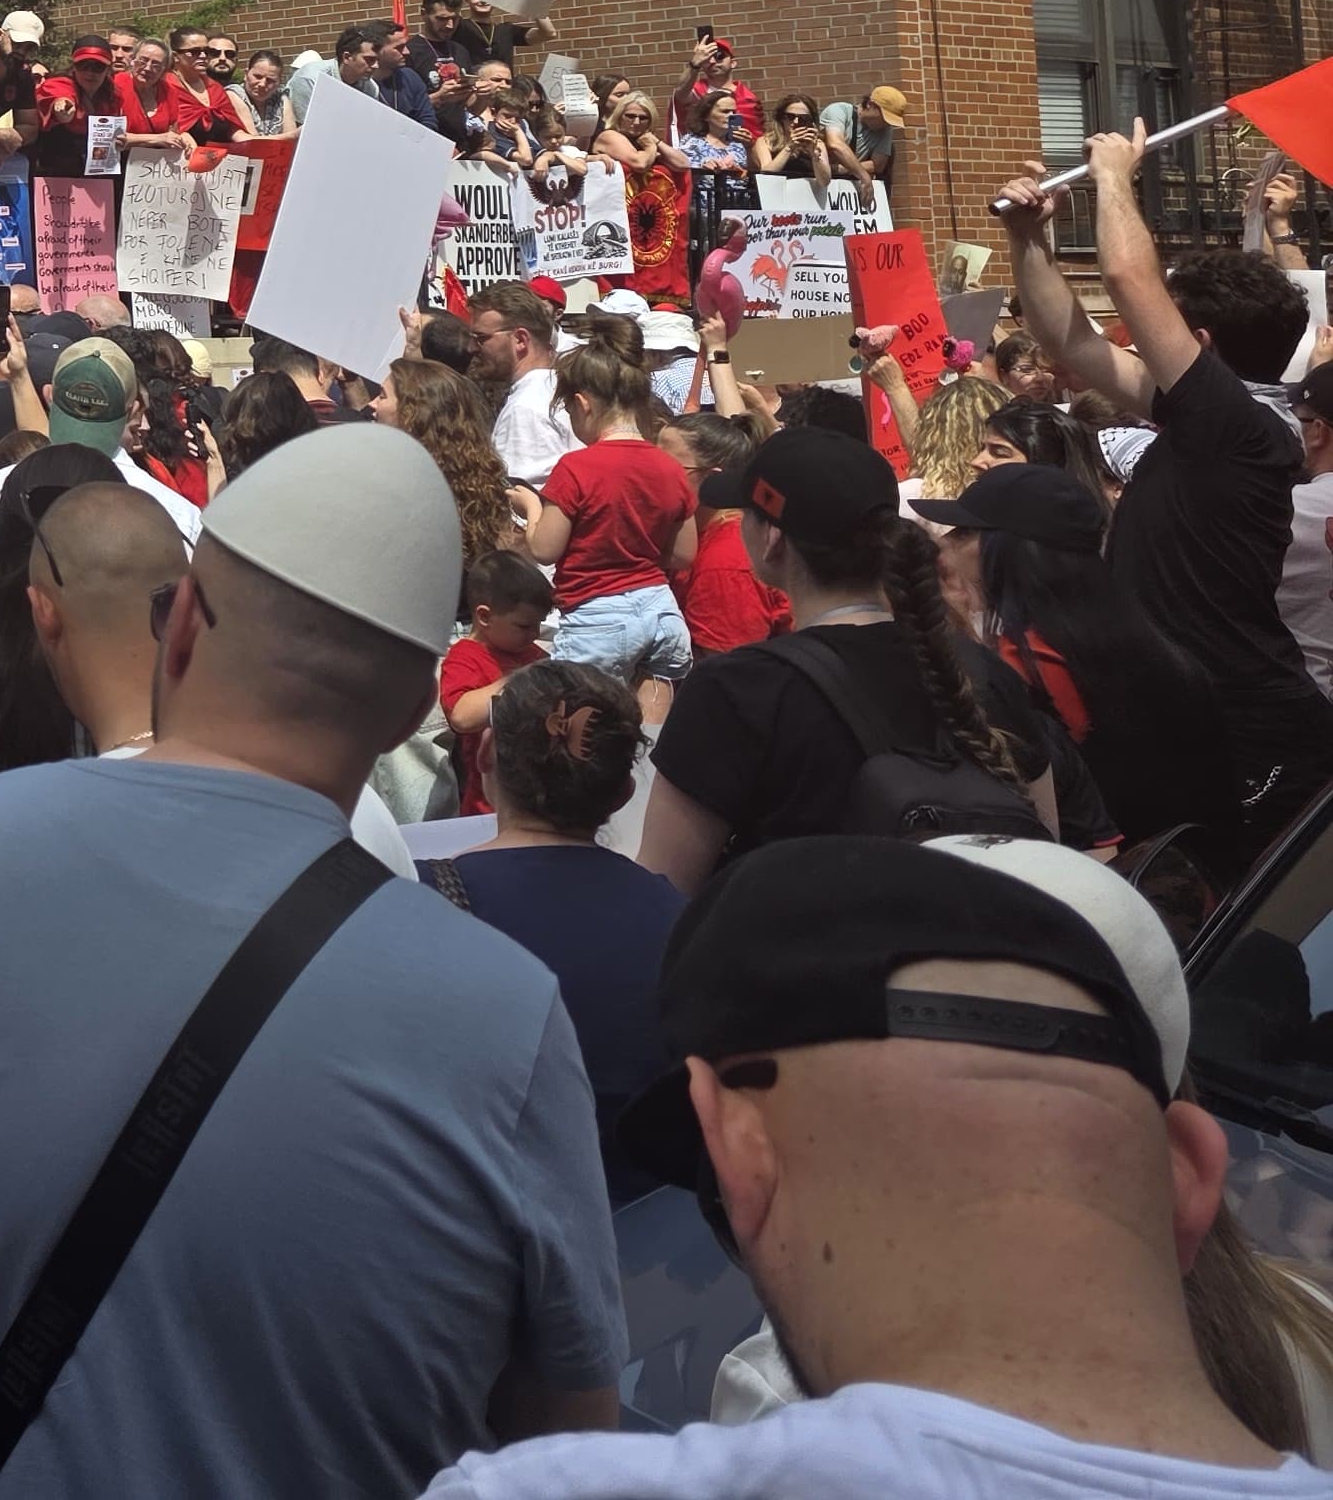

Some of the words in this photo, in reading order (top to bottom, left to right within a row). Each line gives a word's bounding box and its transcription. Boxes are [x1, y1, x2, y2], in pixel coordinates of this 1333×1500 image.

[534, 204, 586, 233] STOP!
[744, 214, 769, 229] Our
[765, 227, 787, 240] than
[788, 226, 809, 241] your
[876, 242, 905, 270] OUR
[794, 271, 819, 283] SELL
[823, 273, 848, 284] YOU
[791, 290, 829, 302] HOUSE
[834, 292, 851, 303] NO
